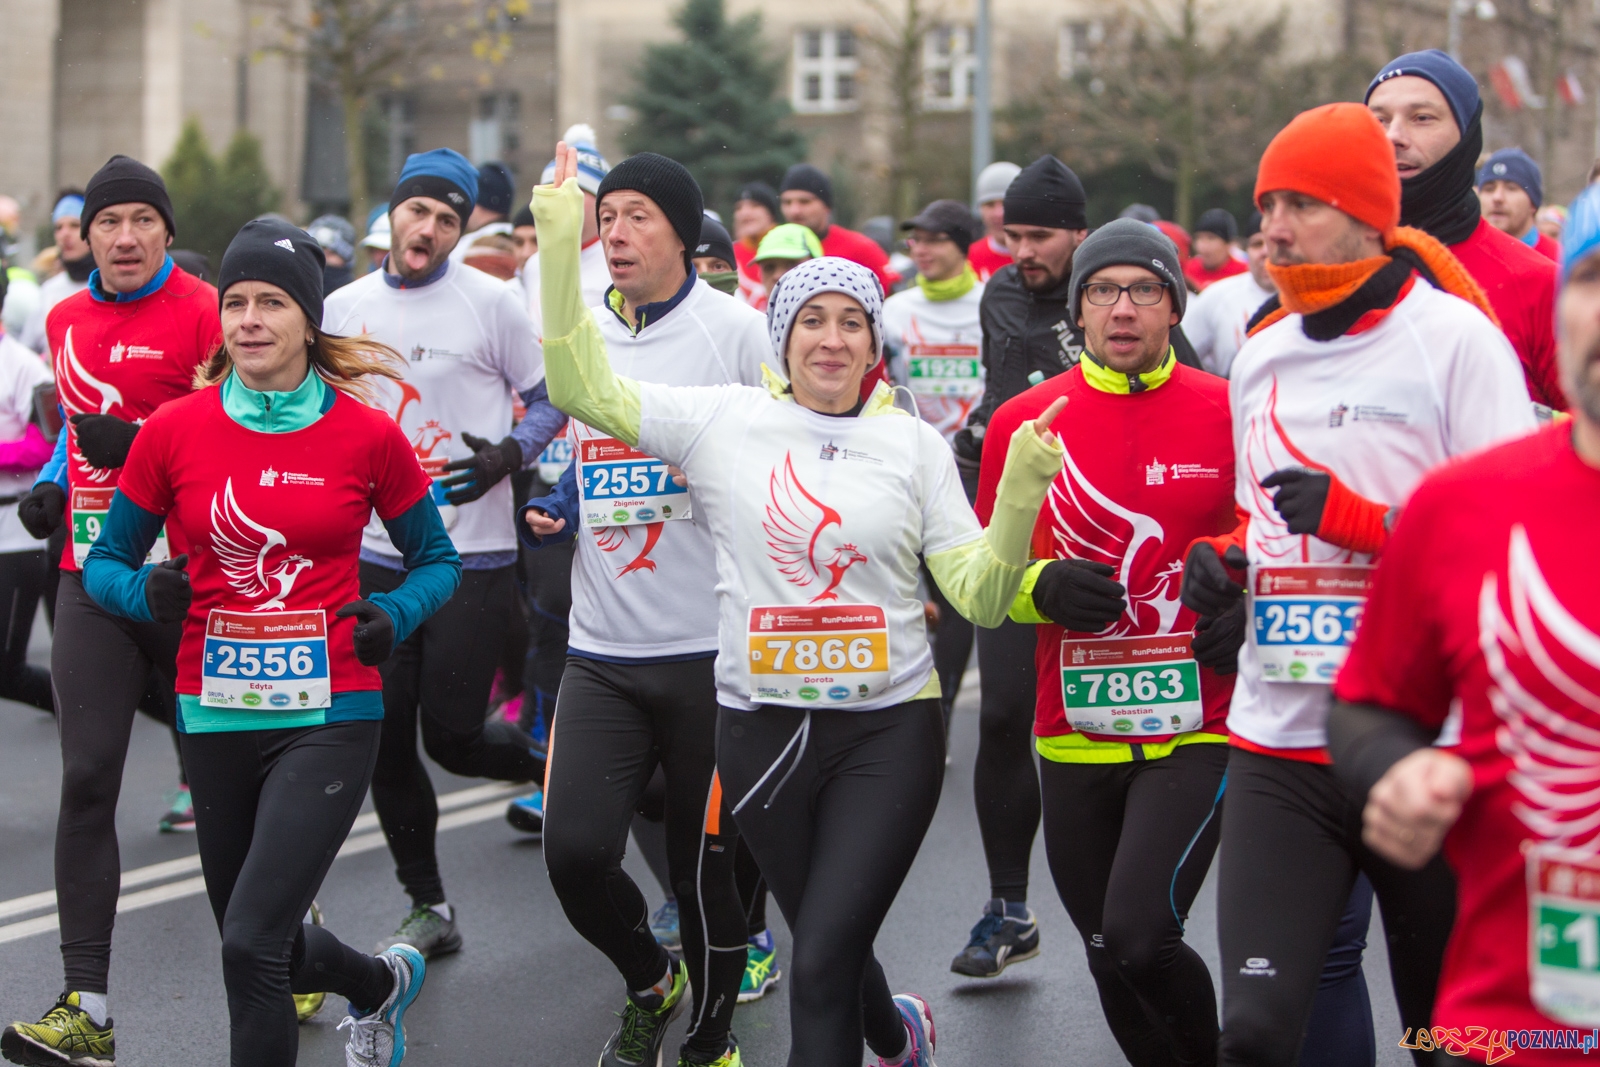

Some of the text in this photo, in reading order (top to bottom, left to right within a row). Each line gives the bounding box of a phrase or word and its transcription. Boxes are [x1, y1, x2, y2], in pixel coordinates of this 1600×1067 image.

[1051, 319, 1083, 362] FILA
[585, 478, 590, 488] E
[592, 465, 669, 496] 2557
[613, 500, 645, 508] Zbigniew
[822, 615, 878, 624] RunPoland.org
[264, 624, 317, 633] RunPoland.org
[751, 650, 763, 661] D
[766, 637, 874, 671] 7866
[1132, 646, 1187, 656] RunPoland.org
[206, 652, 214, 663] E
[216, 645, 314, 677] 2556
[249, 683, 273, 691] Edyta
[1066, 683, 1077, 695] C
[1080, 668, 1184, 703] 7863
[207, 697, 229, 705] LUXMED
[1111, 708, 1154, 716] Sebastian
